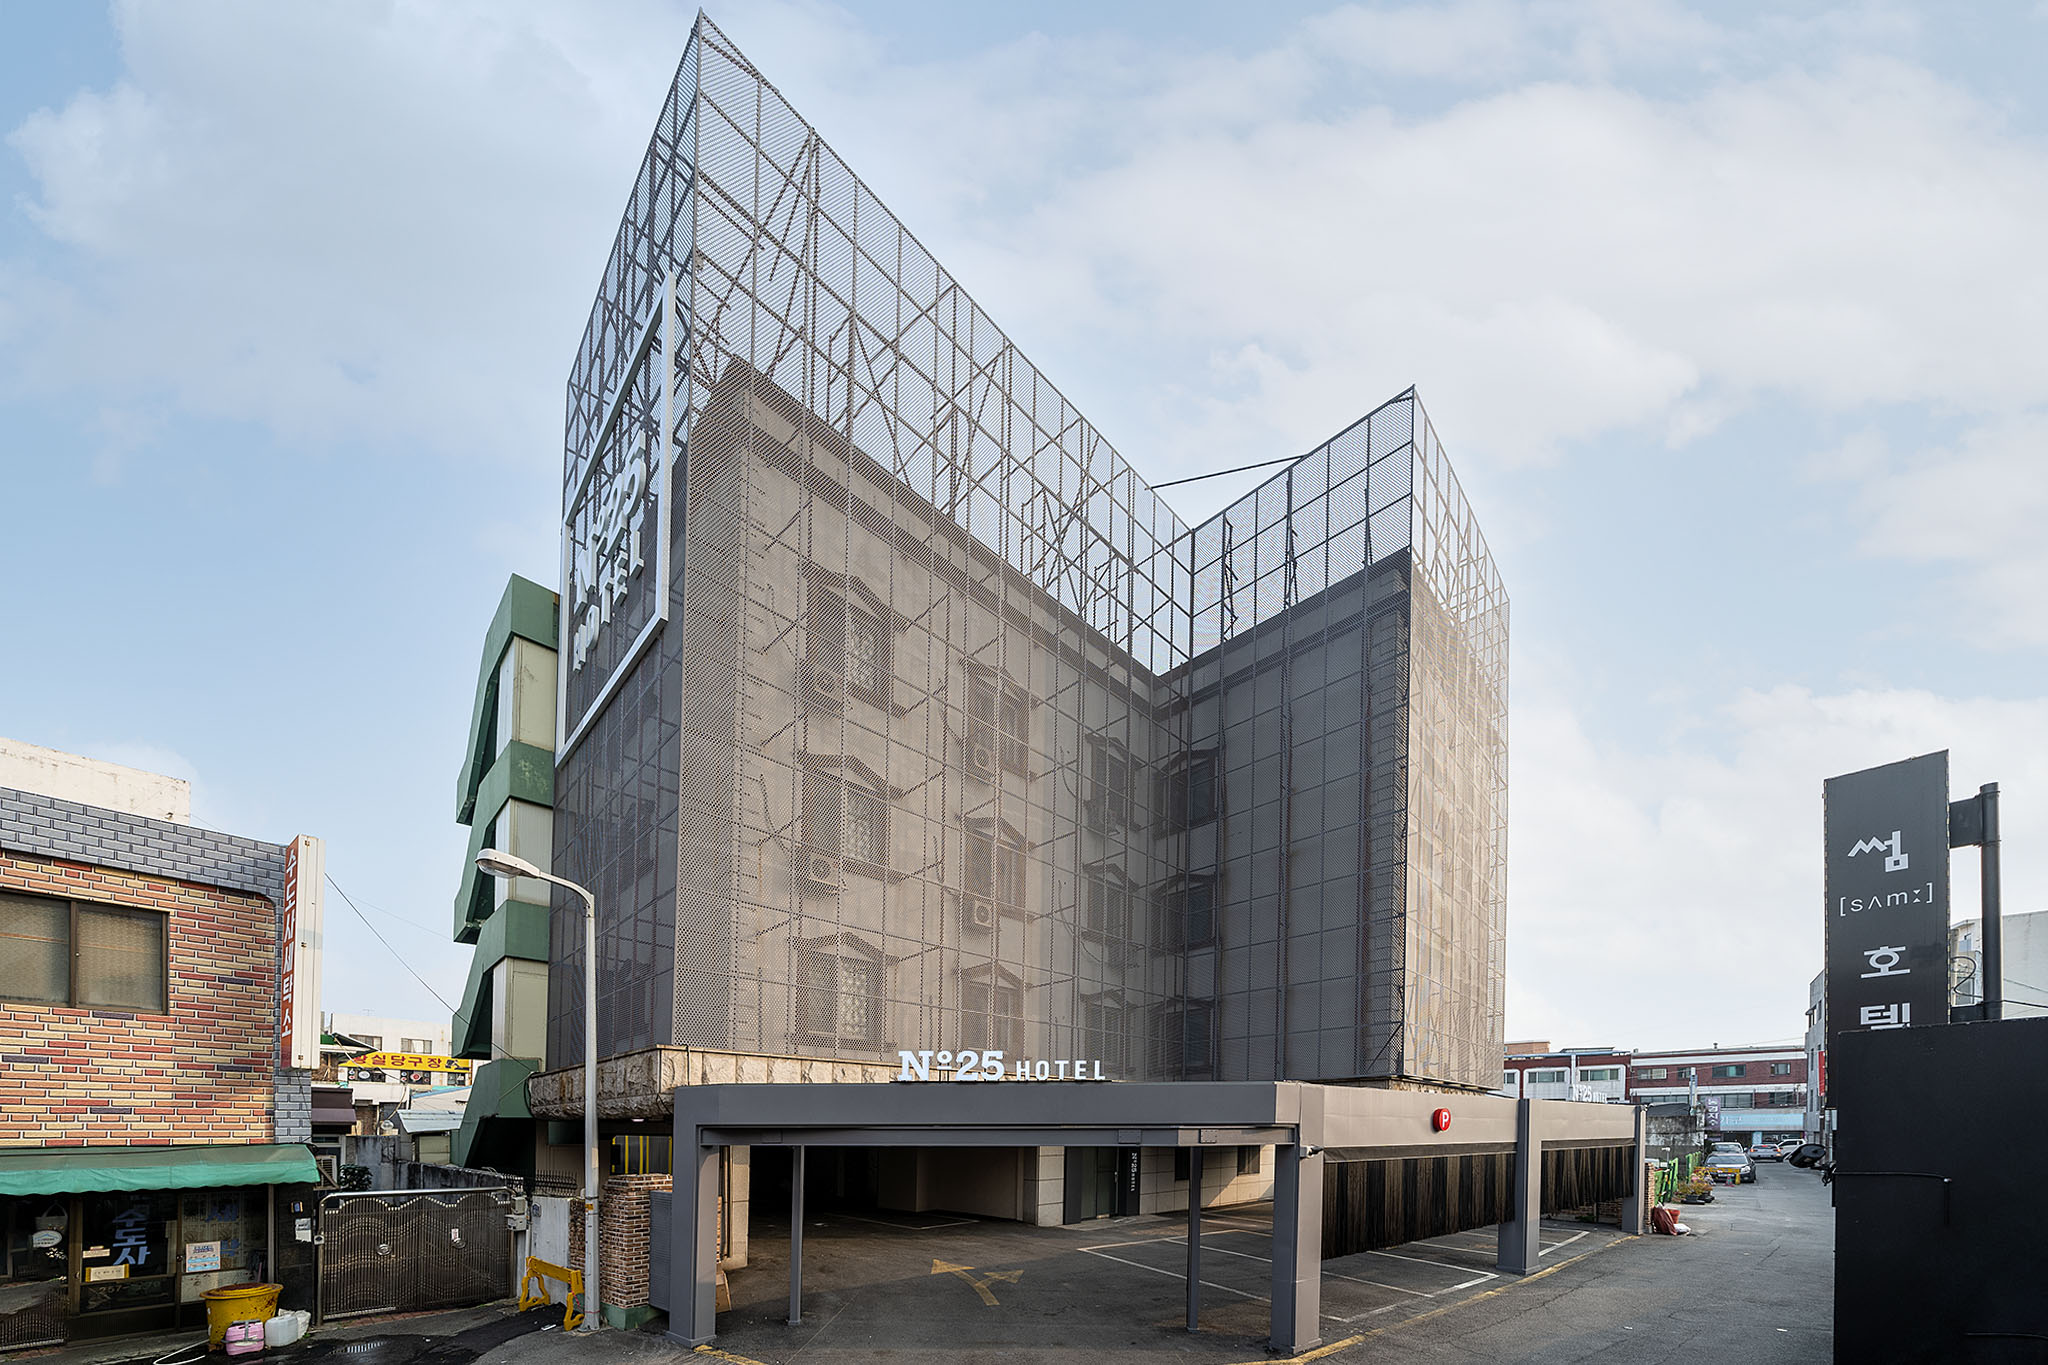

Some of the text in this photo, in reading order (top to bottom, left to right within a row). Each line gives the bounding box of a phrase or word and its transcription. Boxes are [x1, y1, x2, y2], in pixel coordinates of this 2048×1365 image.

[1847, 830, 1909, 873] 썸
[1016, 1060, 1106, 1081] HOTEL
[1442, 1111, 1450, 1128] P
